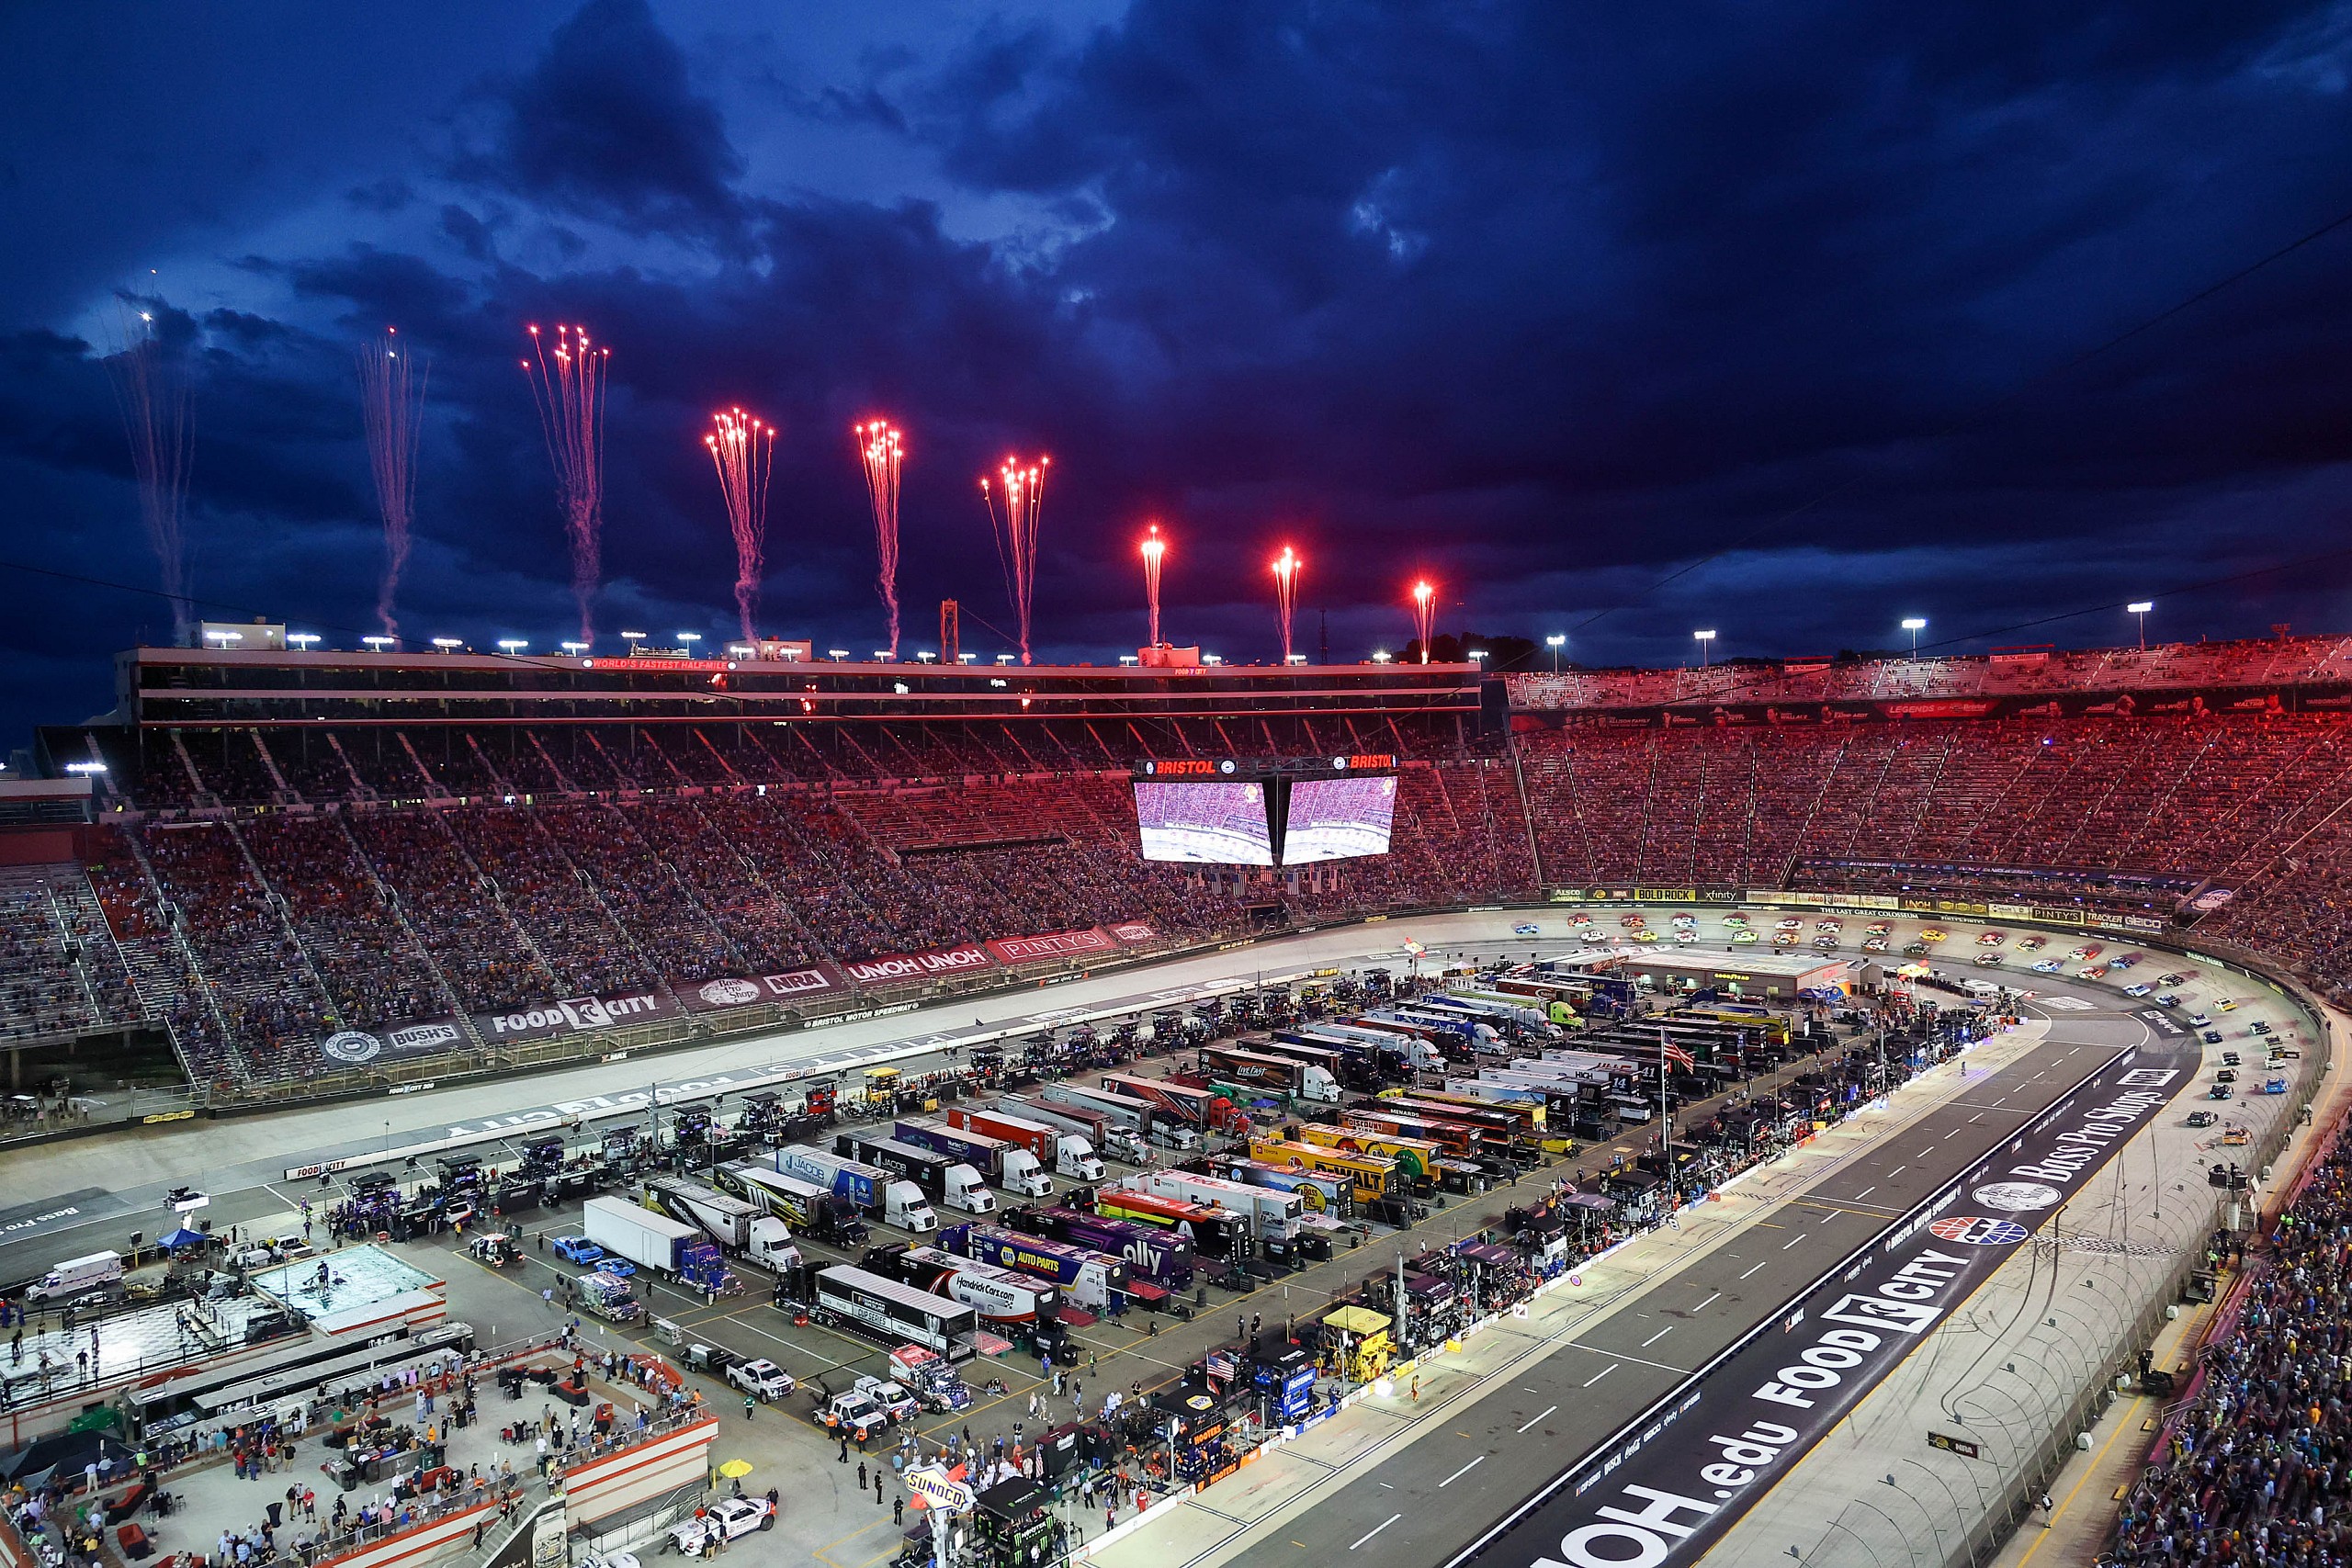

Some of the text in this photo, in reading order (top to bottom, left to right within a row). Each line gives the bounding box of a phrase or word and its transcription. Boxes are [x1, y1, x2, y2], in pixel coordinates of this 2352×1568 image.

[593, 659, 727, 671] WORLD'S FASTEST HALF-MILE
[1157, 761, 1216, 774] BRISTOL
[1351, 754, 1392, 769] BRISTOL
[1639, 890, 1690, 900] BOLD ROCK
[1706, 890, 1736, 901] xfinity
[1905, 899, 1931, 908] UNOH
[2035, 909, 2079, 921] PINTY'S
[2086, 912, 2122, 923] TRACKER
[2125, 914, 2162, 929] GEICO
[1118, 928, 1151, 939] BUSH'S
[1006, 932, 1097, 955] PINTY'S
[919, 949, 986, 970] UNOH
[848, 958, 920, 979] UNOH
[1714, 973, 1750, 981] GOODYEAR
[718, 978, 742, 987] Bass
[769, 974, 823, 990] NRA
[729, 990, 758, 998] Shops
[492, 995, 656, 1032] FOOD CITY
[811, 1004, 912, 1029] BRISTOL MOTOR SPEEDWAY
[392, 1026, 454, 1045] BUSH'S
[1575, 1071, 1593, 1079] HIGH
[1642, 1066, 1655, 1077] 41
[1612, 1077, 1626, 1089] 14
[1391, 1109, 1419, 1117] MENARDS
[1551, 1100, 1562, 1110] 4
[2084, 1090, 2170, 1123] Shops
[1349, 1119, 1383, 1131] DISCOUNT
[2055, 1122, 2125, 1147] Pro
[298, 1160, 346, 1178] FOOD CITY
[794, 1159, 824, 1180] JACOB
[882, 1157, 907, 1172] JACOB
[2008, 1145, 2099, 1183] Bass
[747, 1184, 771, 1215] 00
[1303, 1185, 1318, 1197] Bass
[6, 1206, 80, 1231] Bass Pro
[1891, 1189, 1958, 1246] BRISTOL MOTOR SPEEDWAY
[1017, 1251, 1059, 1273] AUTO PARTS
[1124, 1240, 1162, 1276] ally
[864, 1298, 885, 1314] NASCAR
[857, 1308, 887, 1325] CUP SERIES
[1751, 1248, 1971, 1409] FOOD CITY
[1287, 1372, 1314, 1392] FASTENAL
[1304, 1413, 1326, 1432] FASTENAL
[1664, 1410, 1677, 1427] xfinity
[1194, 1425, 1222, 1446] HOOTERS
[1644, 1423, 1661, 1443] GEICO
[1955, 1443, 1973, 1454] NRA
[1210, 1463, 1237, 1484] HOOTERS
[1604, 1453, 1622, 1477] BUSCH
[908, 1473, 962, 1506] SUNOCO
[1581, 1482, 1589, 1494] CUP
[1021, 1522, 1046, 1540] MONSTER
